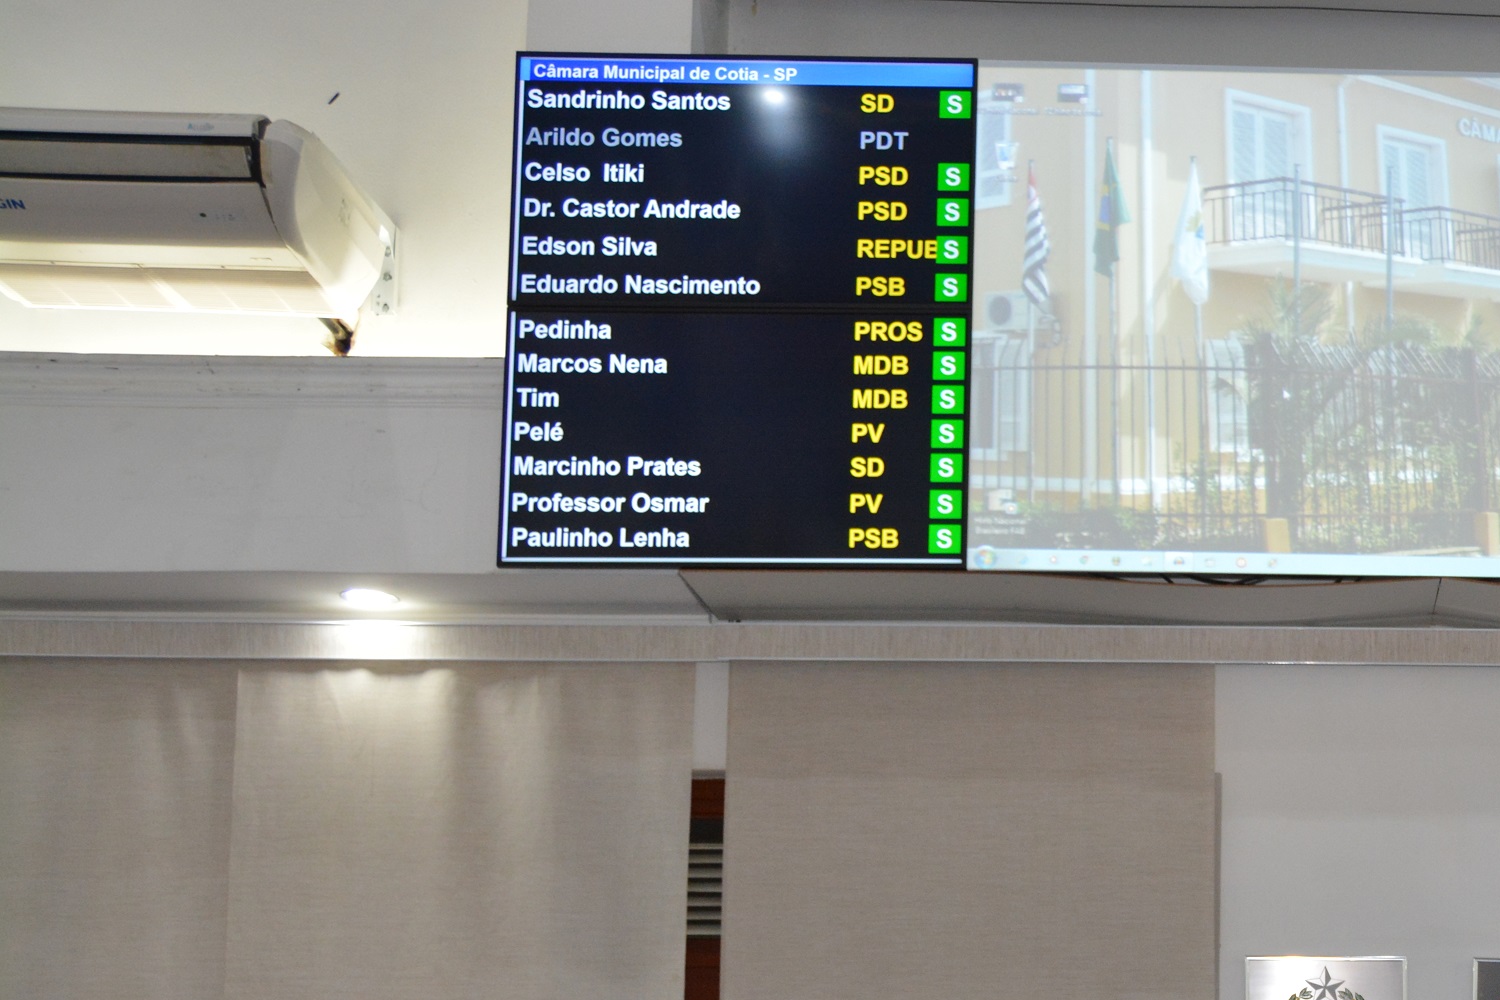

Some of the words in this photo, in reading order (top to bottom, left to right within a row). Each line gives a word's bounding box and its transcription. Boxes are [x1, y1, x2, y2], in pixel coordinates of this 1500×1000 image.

[535, 64, 598, 78] Câmara
[604, 65, 684, 82] Municipal
[690, 67, 710, 79] de
[715, 67, 758, 80] Cotia
[774, 68, 797, 81] SP
[527, 89, 645, 110] Sandrinho
[651, 89, 731, 110] Santos
[861, 94, 894, 113] SD
[948, 95, 962, 113] S
[526, 127, 595, 146] Arildo
[602, 127, 682, 147] Gomes
[860, 131, 909, 150] PDT
[524, 162, 590, 182] Celso
[602, 163, 644, 182] Itiki
[859, 166, 908, 185] PSD
[946, 168, 960, 186] S
[523, 198, 555, 217] Dr.
[561, 197, 640, 218] Castor
[643, 198, 741, 219] Andrade
[858, 201, 907, 221] PSD
[945, 203, 960, 221] S
[522, 236, 595, 255] Edson
[601, 236, 657, 256] Silva
[944, 240, 959, 259] S
[520, 274, 618, 293] Eduardo
[624, 274, 760, 295] Nascimento
[856, 277, 905, 296] PSB
[943, 278, 958, 296] S
[518, 319, 611, 339] Pedinha
[855, 322, 923, 342] PROS
[942, 322, 956, 341] S
[517, 353, 602, 373] Marcos
[608, 354, 667, 374] Nena
[854, 355, 909, 375] MDB
[941, 356, 956, 375] S
[516, 387, 559, 407] Tim
[853, 389, 908, 409] MDB
[940, 390, 955, 409] S
[513, 421, 564, 441] Pelé
[852, 423, 885, 443] PV
[939, 424, 954, 443] S
[512, 456, 621, 476] Marcinho
[626, 456, 701, 476] Prates
[850, 457, 884, 477] SD
[938, 458, 954, 477] S
[511, 492, 626, 512] Professor
[630, 492, 710, 513] Osmar
[850, 494, 883, 513] PV
[938, 494, 953, 514] S
[511, 527, 613, 547] Paulinho
[618, 527, 689, 547] Lenha
[849, 528, 899, 548] PSB
[937, 529, 952, 548] S
